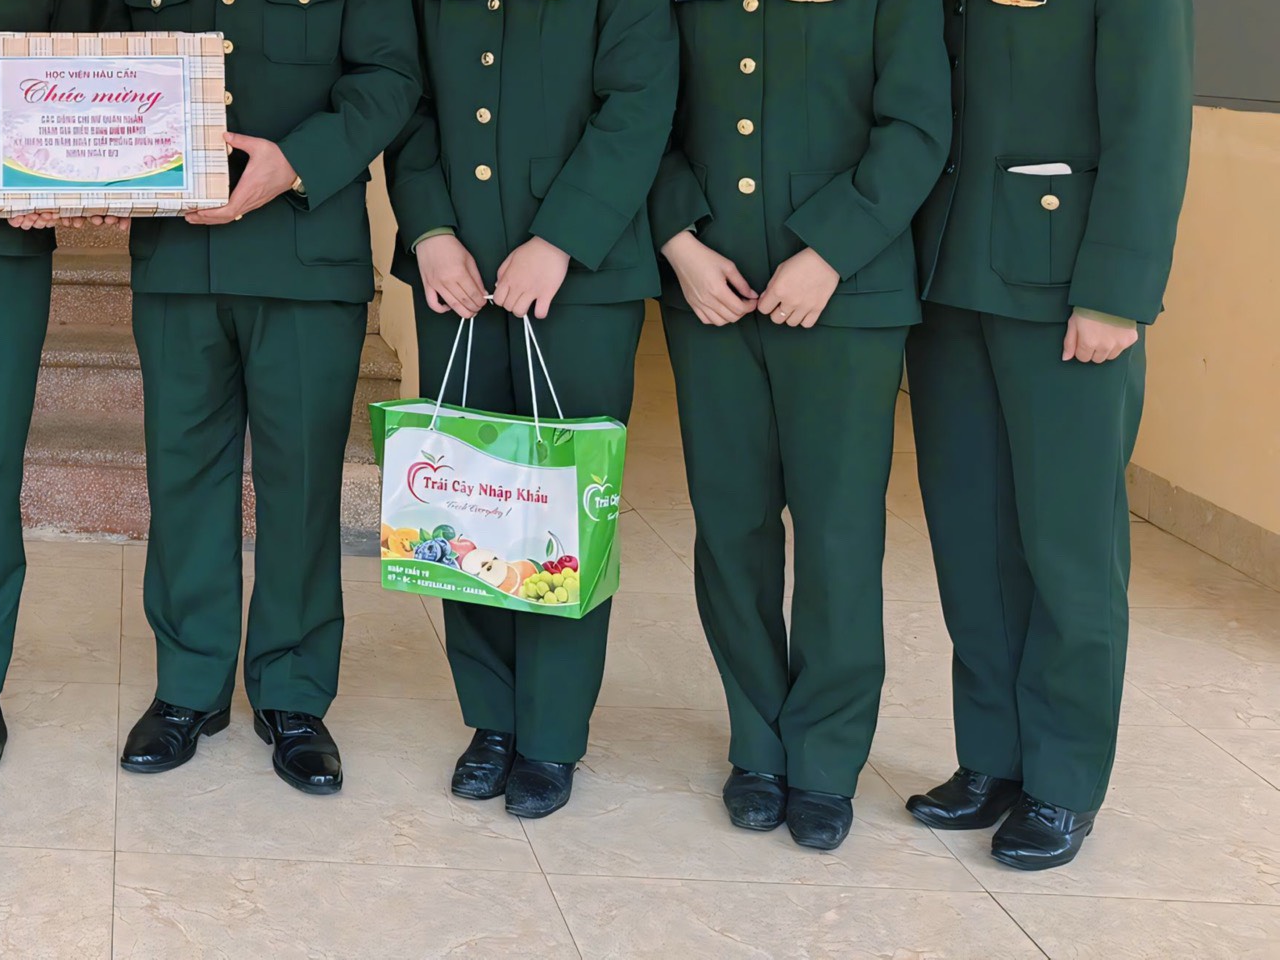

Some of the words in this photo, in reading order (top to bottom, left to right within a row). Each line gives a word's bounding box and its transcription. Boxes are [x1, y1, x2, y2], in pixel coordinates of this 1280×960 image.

[45, 70, 66, 81] HỌC
[19, 78, 86, 104] Chúc
[90, 86, 165, 115] mừng
[423, 476, 448, 491] Trái
[451, 480, 475, 497] Cây
[479, 483, 513, 502] Nhập
[517, 486, 549, 504] Khẩu
